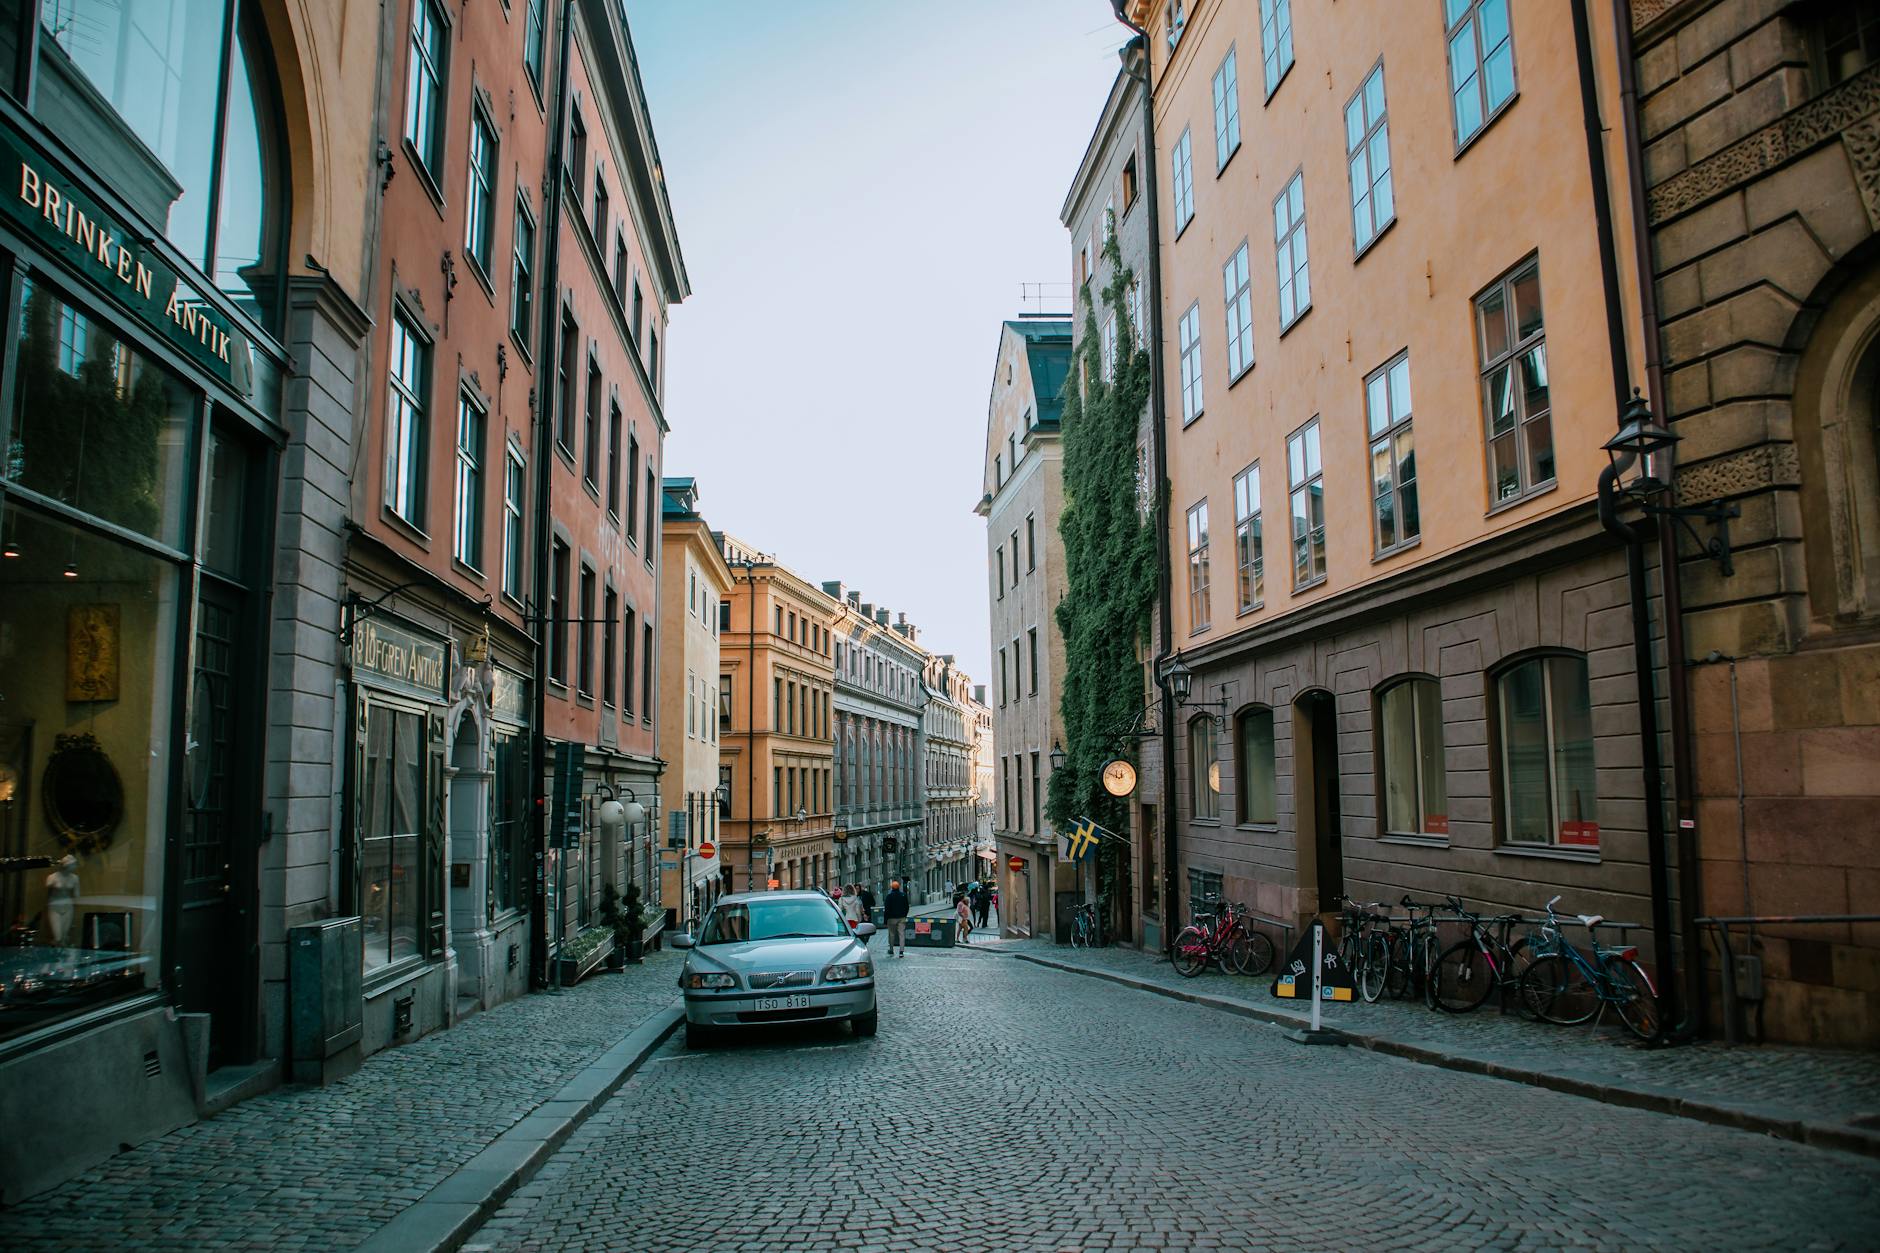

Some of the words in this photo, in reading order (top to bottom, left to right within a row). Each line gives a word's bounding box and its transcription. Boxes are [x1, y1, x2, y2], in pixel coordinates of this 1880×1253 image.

[20, 162, 153, 300] BRINKEN
[164, 291, 231, 364] ANTIK
[407, 641, 438, 687] ANTIK
[757, 999, 778, 1009] TSO
[786, 997, 807, 1008] 818
